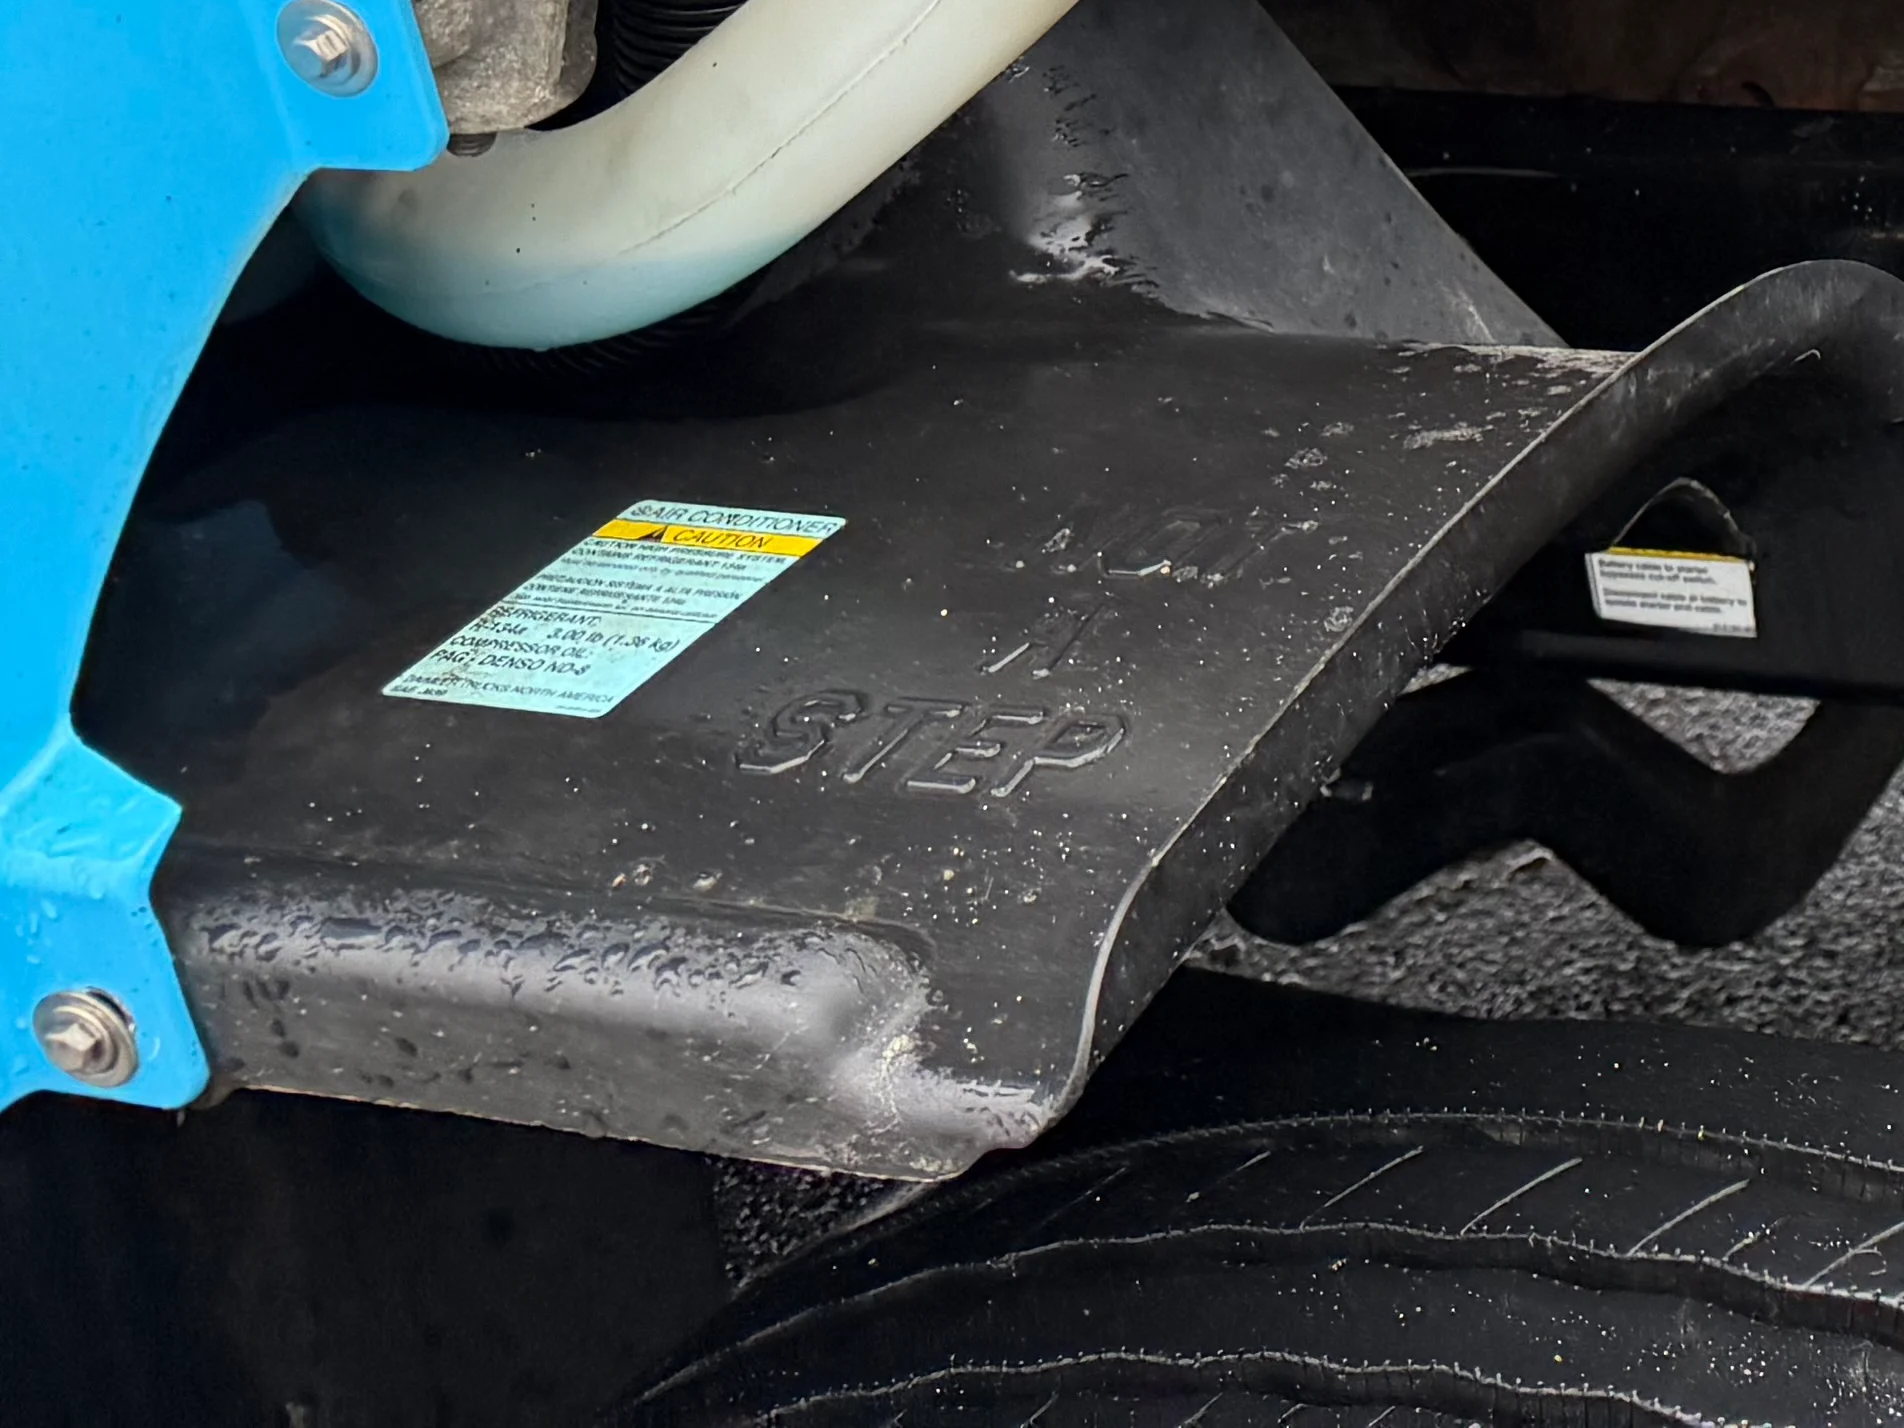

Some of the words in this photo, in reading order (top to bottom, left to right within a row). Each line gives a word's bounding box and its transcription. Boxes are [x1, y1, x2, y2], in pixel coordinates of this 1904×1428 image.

[647, 505, 692, 520] AIR
[683, 508, 840, 535] CONDITIONER
[669, 528, 775, 549] CAUTION
[446, 634, 565, 656] COMPRESSOR
[581, 631, 609, 643] lb
[643, 637, 684, 652] kg)
[426, 648, 473, 663] PAG
[475, 654, 548, 670] DENSO
[733, 688, 1127, 799] STEP
